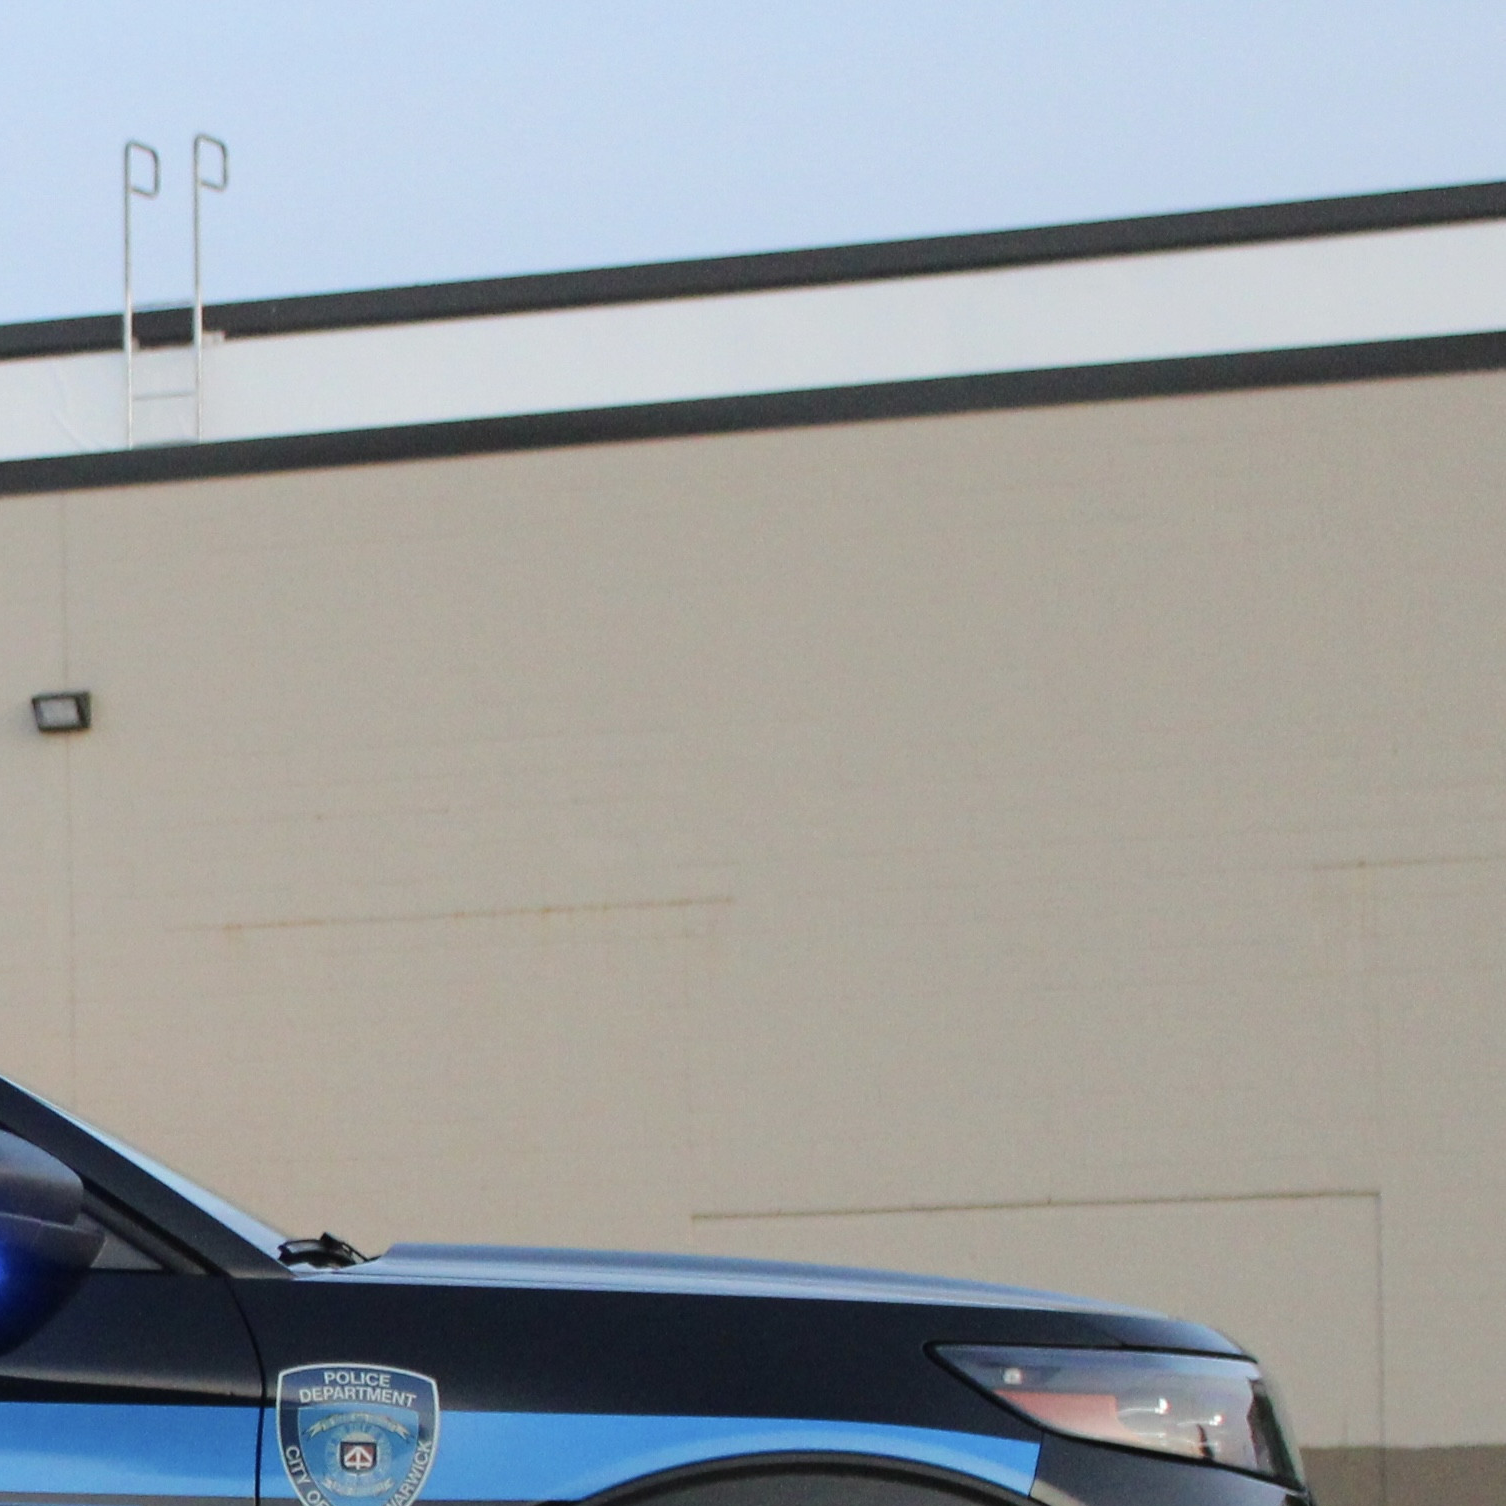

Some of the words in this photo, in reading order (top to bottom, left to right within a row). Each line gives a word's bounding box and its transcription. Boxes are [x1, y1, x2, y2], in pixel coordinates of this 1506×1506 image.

[323, 1370, 391, 1388] POLICE
[299, 1386, 417, 1408] DEPARTMENT
[286, 1445, 312, 1485] CITY
